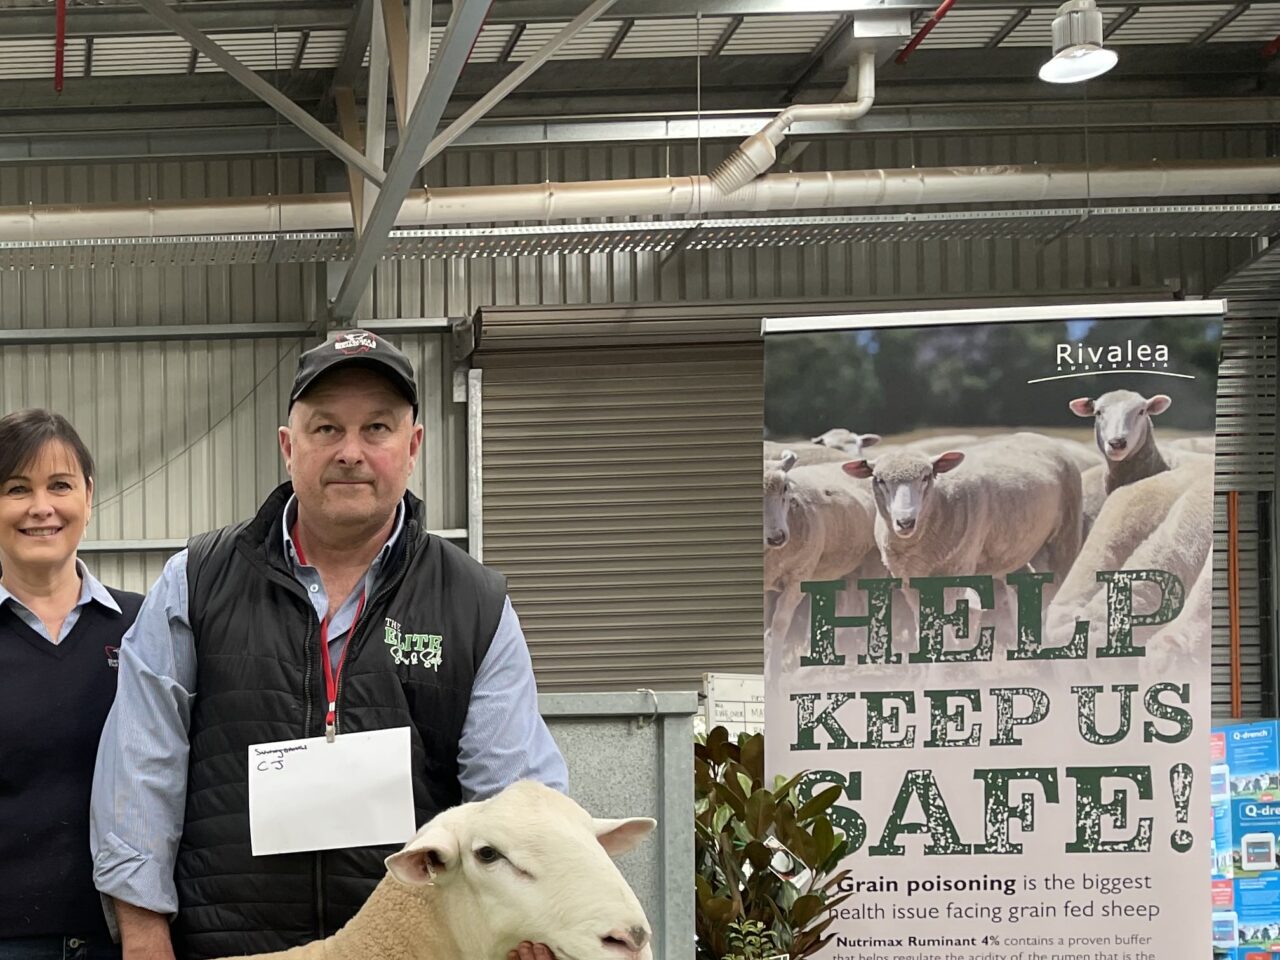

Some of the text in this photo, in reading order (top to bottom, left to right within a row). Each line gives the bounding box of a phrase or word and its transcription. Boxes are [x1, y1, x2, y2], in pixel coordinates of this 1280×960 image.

[1056, 340, 1169, 364] Rivalea
[385, 617, 401, 631] THE
[800, 569, 1185, 667] HELP
[384, 626, 443, 652] ELITE
[789, 682, 1194, 751] KEEP US
[795, 762, 1195, 856] SAFE!
[837, 873, 1152, 896] Grain poisoning is the biggest
[892, 903, 940, 919] issue
[946, 902, 1002, 923] facing
[1008, 902, 1056, 923] grain
[1063, 900, 1094, 918] fed
[1101, 900, 1160, 921] sheep
[836, 934, 1152, 948] Nutrimax Ruminant 4% contains a proven buffer
